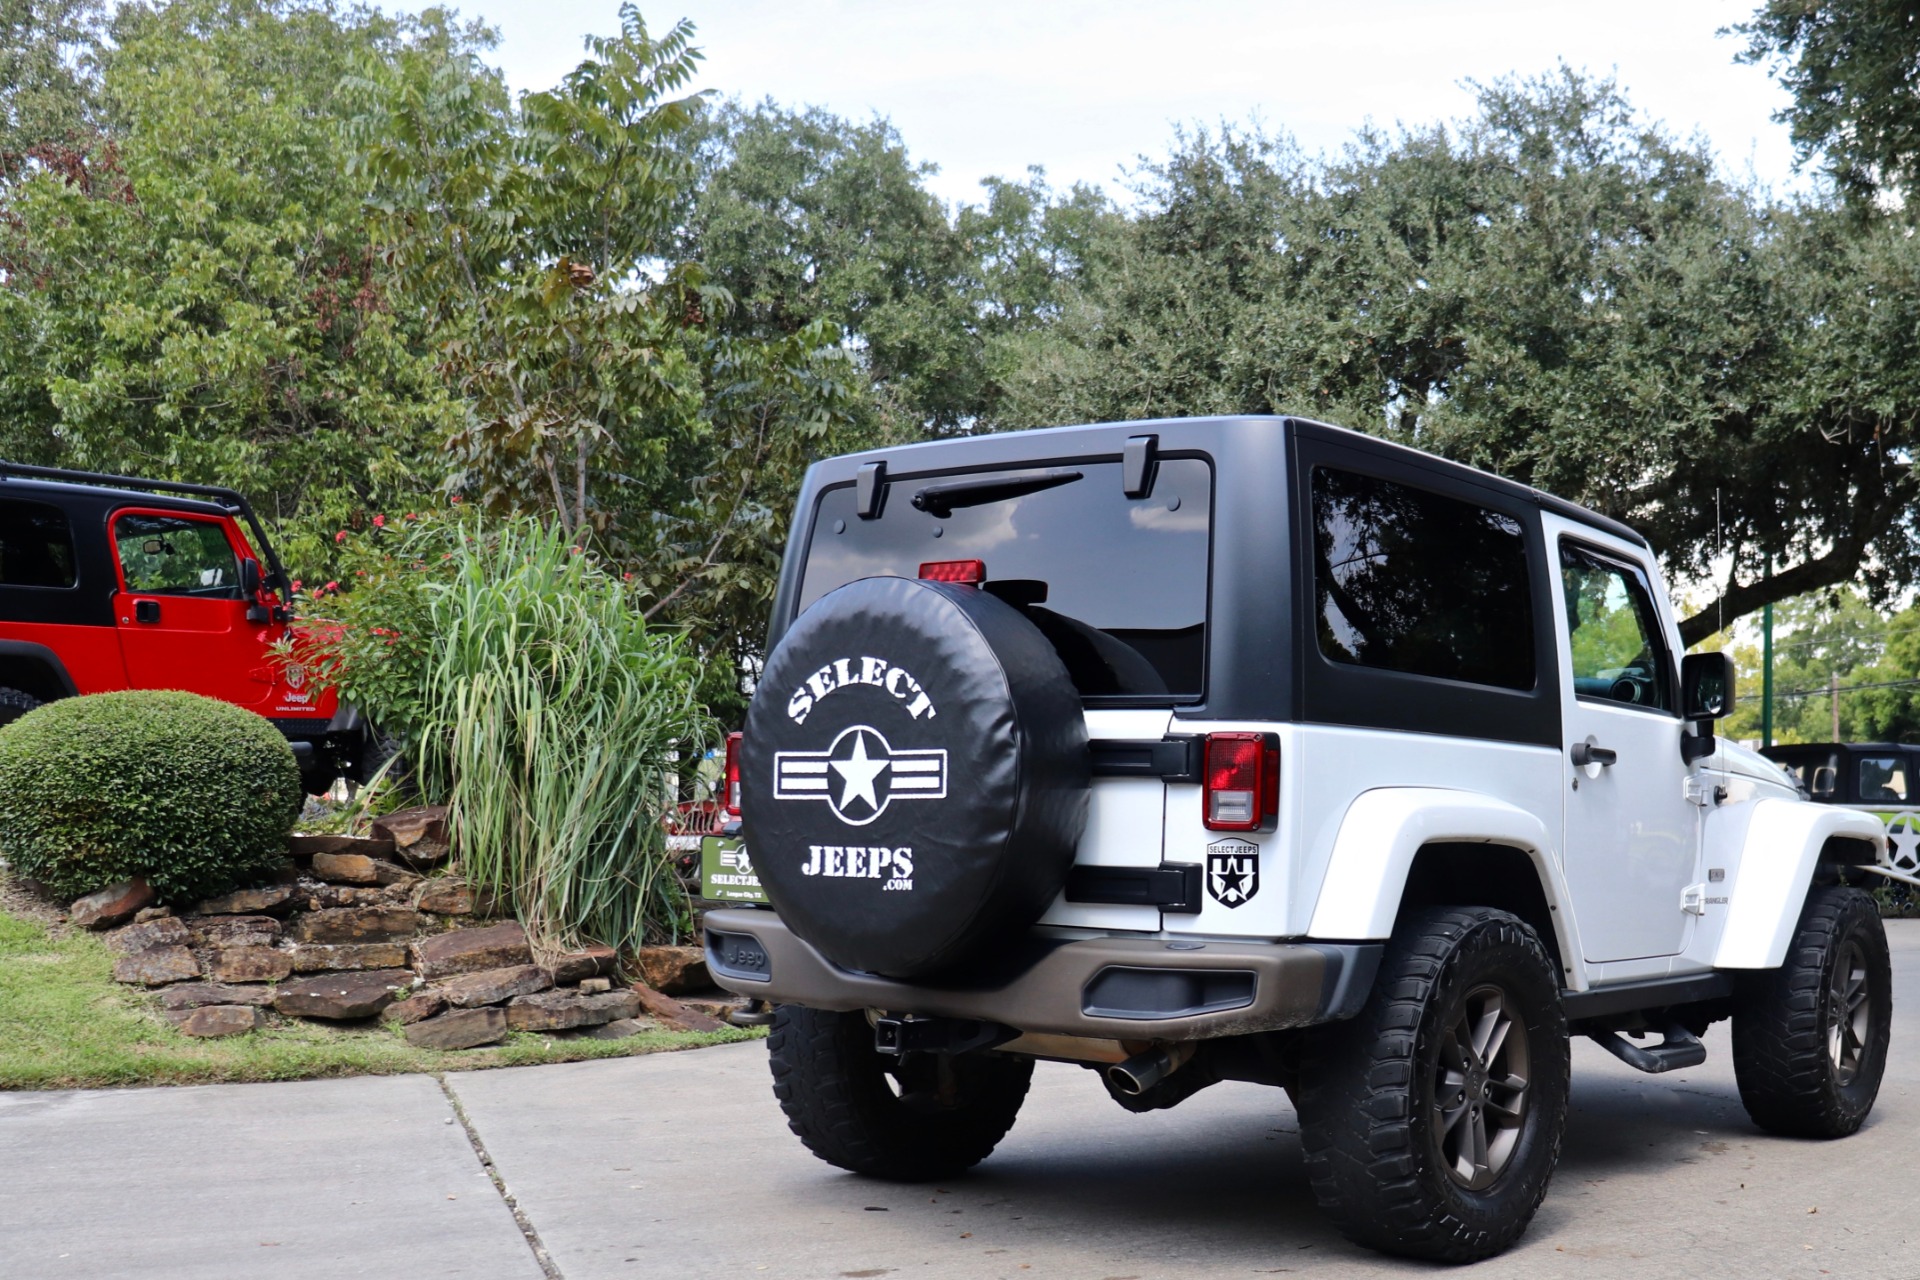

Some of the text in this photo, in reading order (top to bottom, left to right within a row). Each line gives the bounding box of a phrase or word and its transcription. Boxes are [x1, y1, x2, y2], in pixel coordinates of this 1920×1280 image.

[285, 691, 308, 704] Jeep
[788, 656, 937, 725] SELECT
[801, 845, 914, 879] JEEPS
[711, 873, 762, 887] SELECTJE
[883, 879, 913, 891] .COM
[728, 944, 765, 971] Jeep
